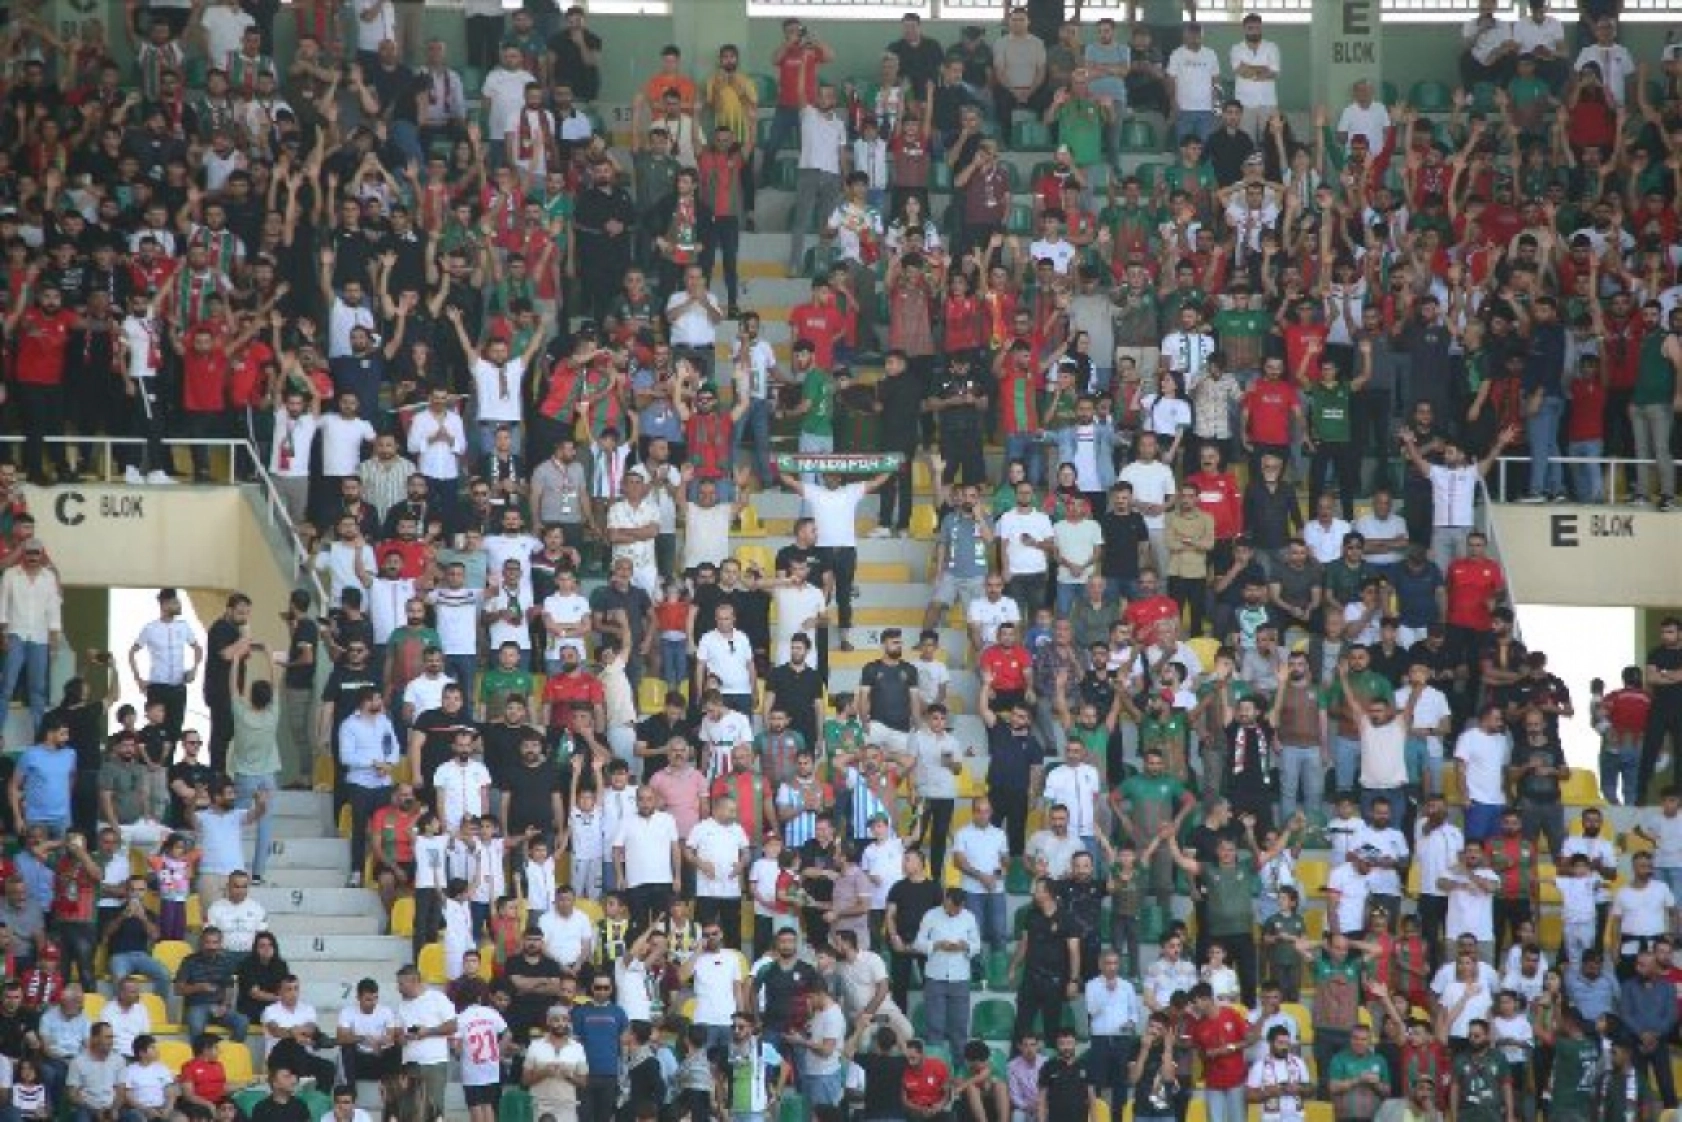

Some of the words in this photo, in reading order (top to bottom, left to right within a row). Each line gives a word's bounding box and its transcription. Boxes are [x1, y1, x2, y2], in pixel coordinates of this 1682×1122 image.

[1343, 2, 1370, 35] E
[1333, 42, 1375, 64] BLOK
[55, 492, 85, 525] C
[102, 494, 144, 518] BLOK
[1551, 514, 1578, 547] E
[1592, 514, 1634, 537] BLOK
[291, 890, 304, 906] 9
[341, 983, 352, 999] 7
[468, 1030, 500, 1066] 21
